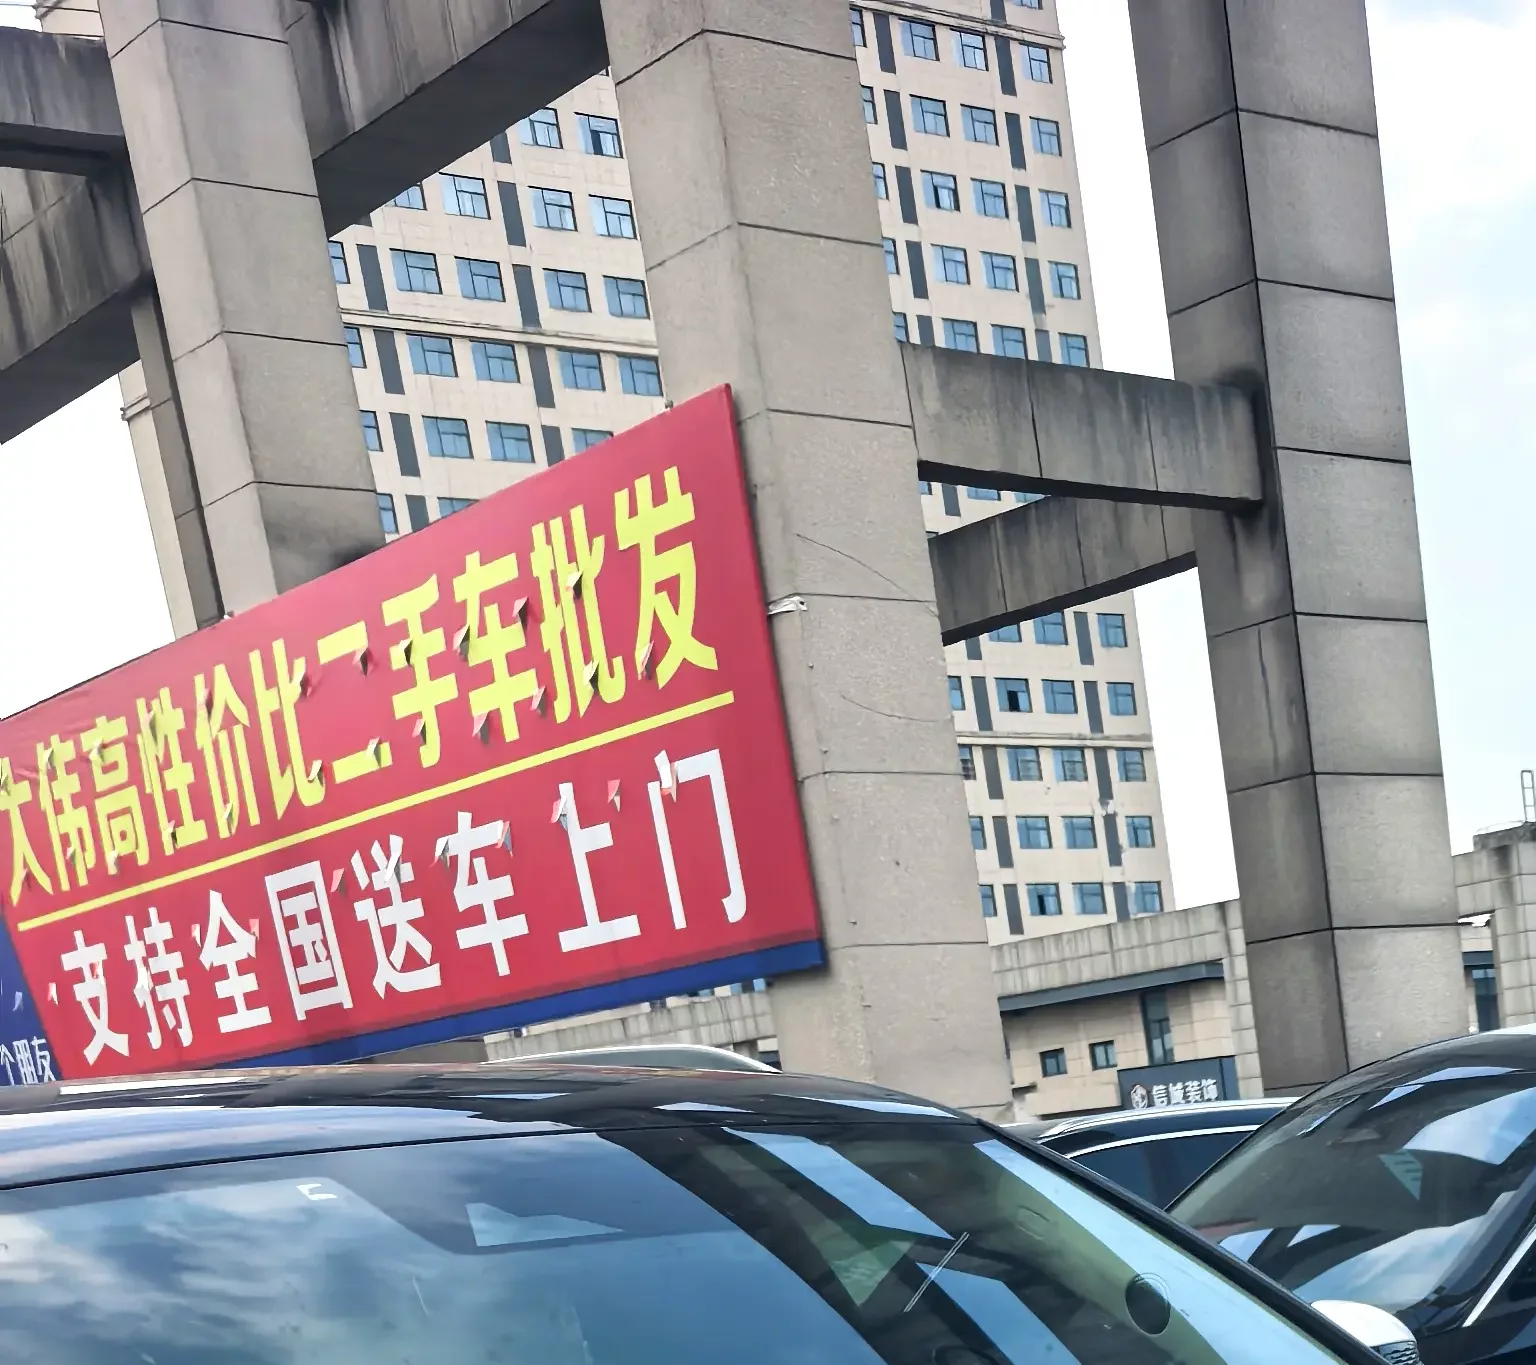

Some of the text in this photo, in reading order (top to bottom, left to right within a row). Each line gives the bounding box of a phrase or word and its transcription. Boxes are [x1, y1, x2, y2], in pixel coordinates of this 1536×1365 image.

[0, 466, 718, 905] 大伟高性价比二手车批发
[61, 748, 747, 1065] 支持全国送车上门
